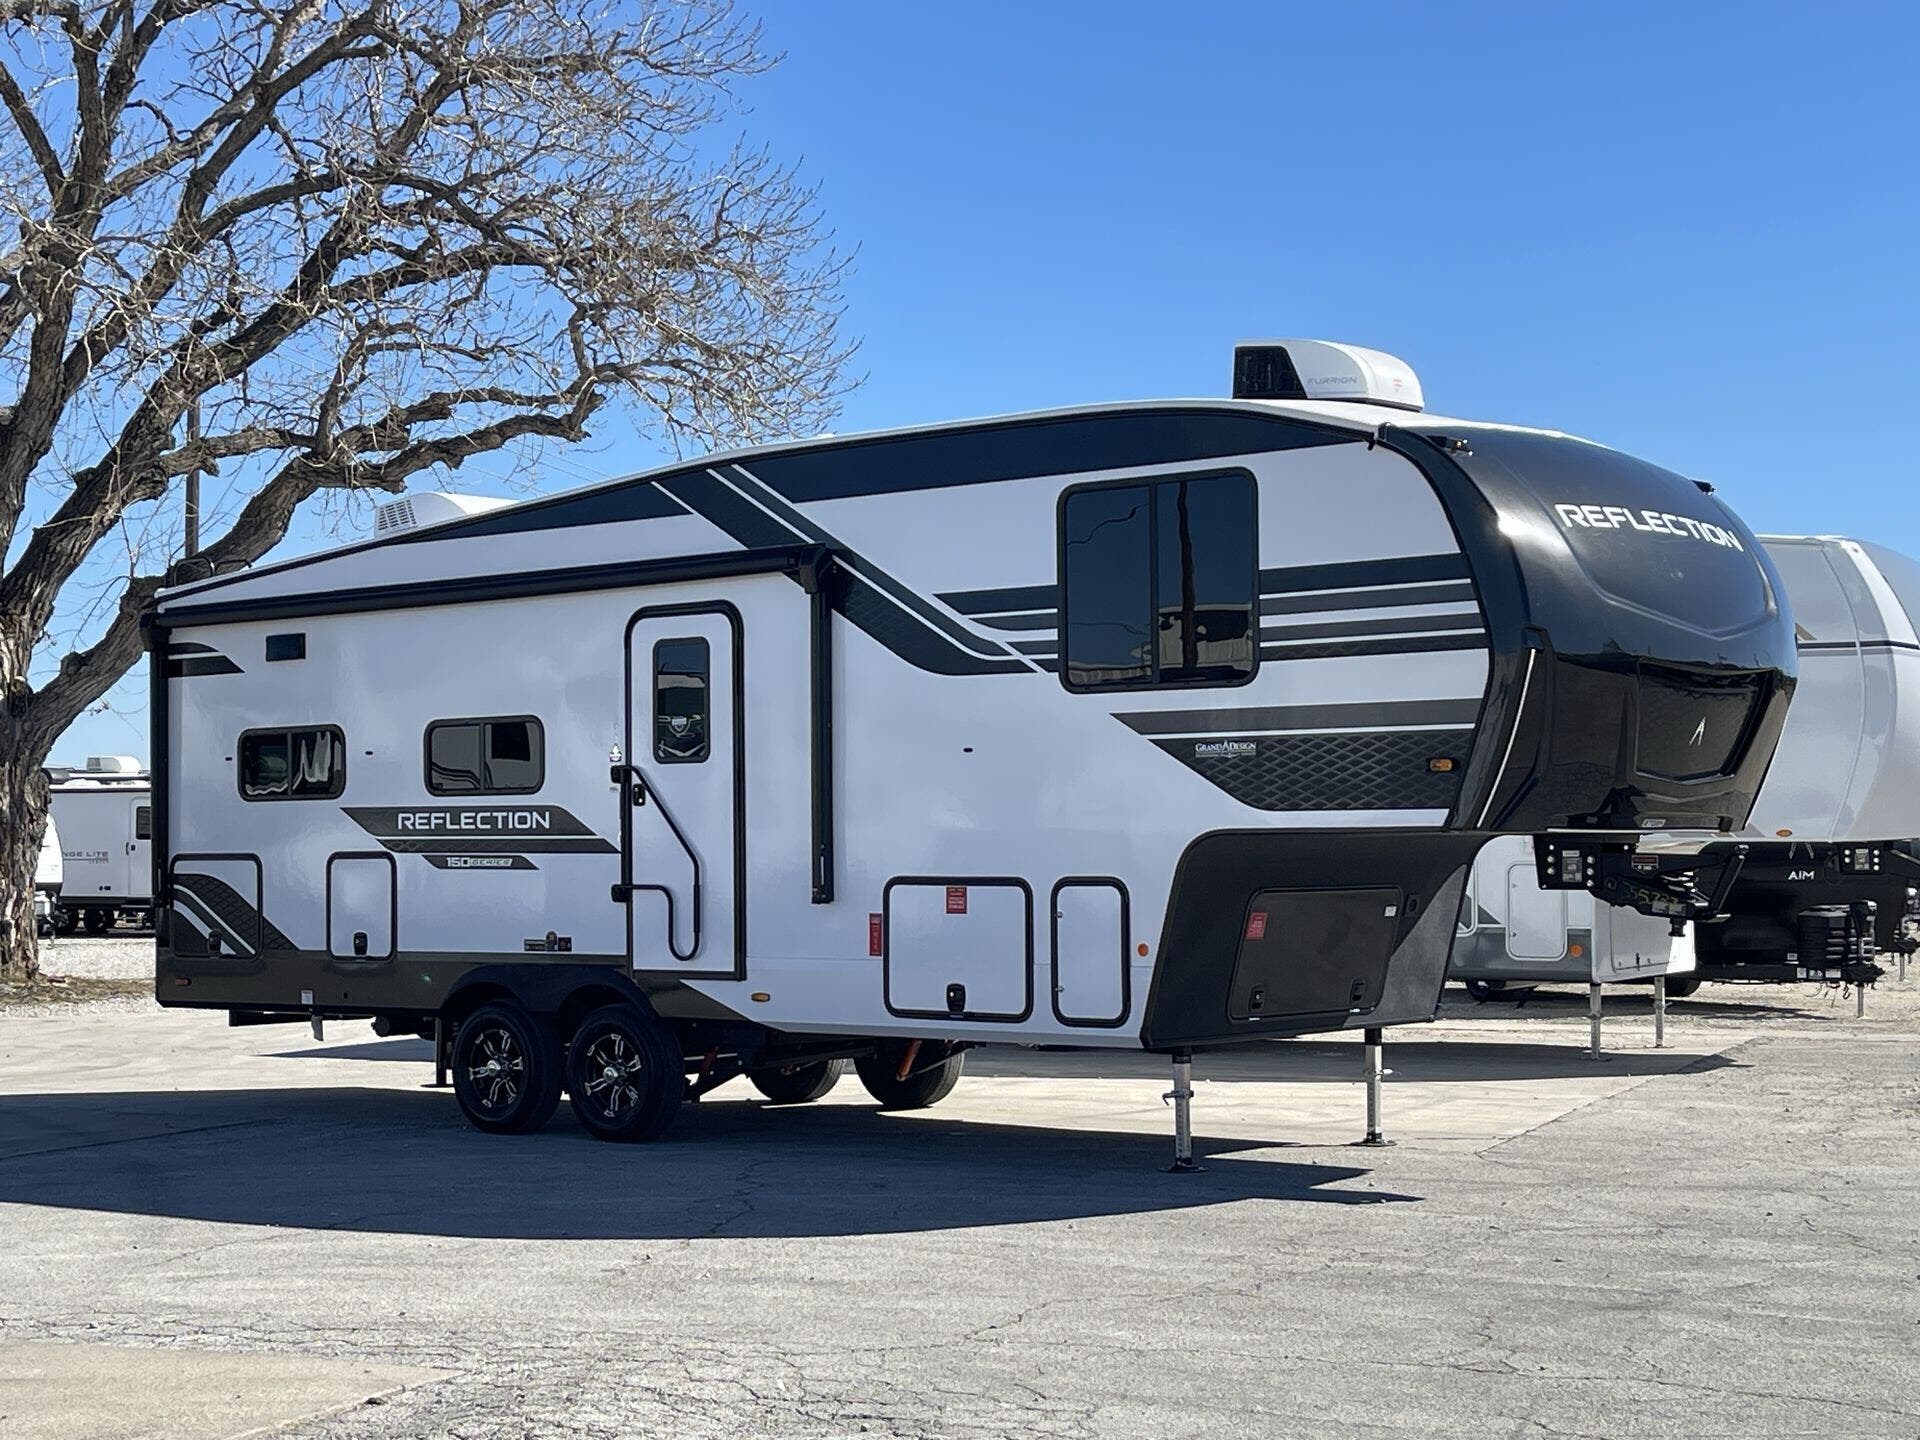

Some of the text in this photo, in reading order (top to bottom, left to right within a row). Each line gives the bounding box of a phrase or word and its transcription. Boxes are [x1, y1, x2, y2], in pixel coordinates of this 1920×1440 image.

[1554, 503, 1744, 552] REFLECTION
[398, 811, 550, 830] REFLECTION
[446, 857, 470, 867] 150
[1788, 870, 1815, 880] AIM
